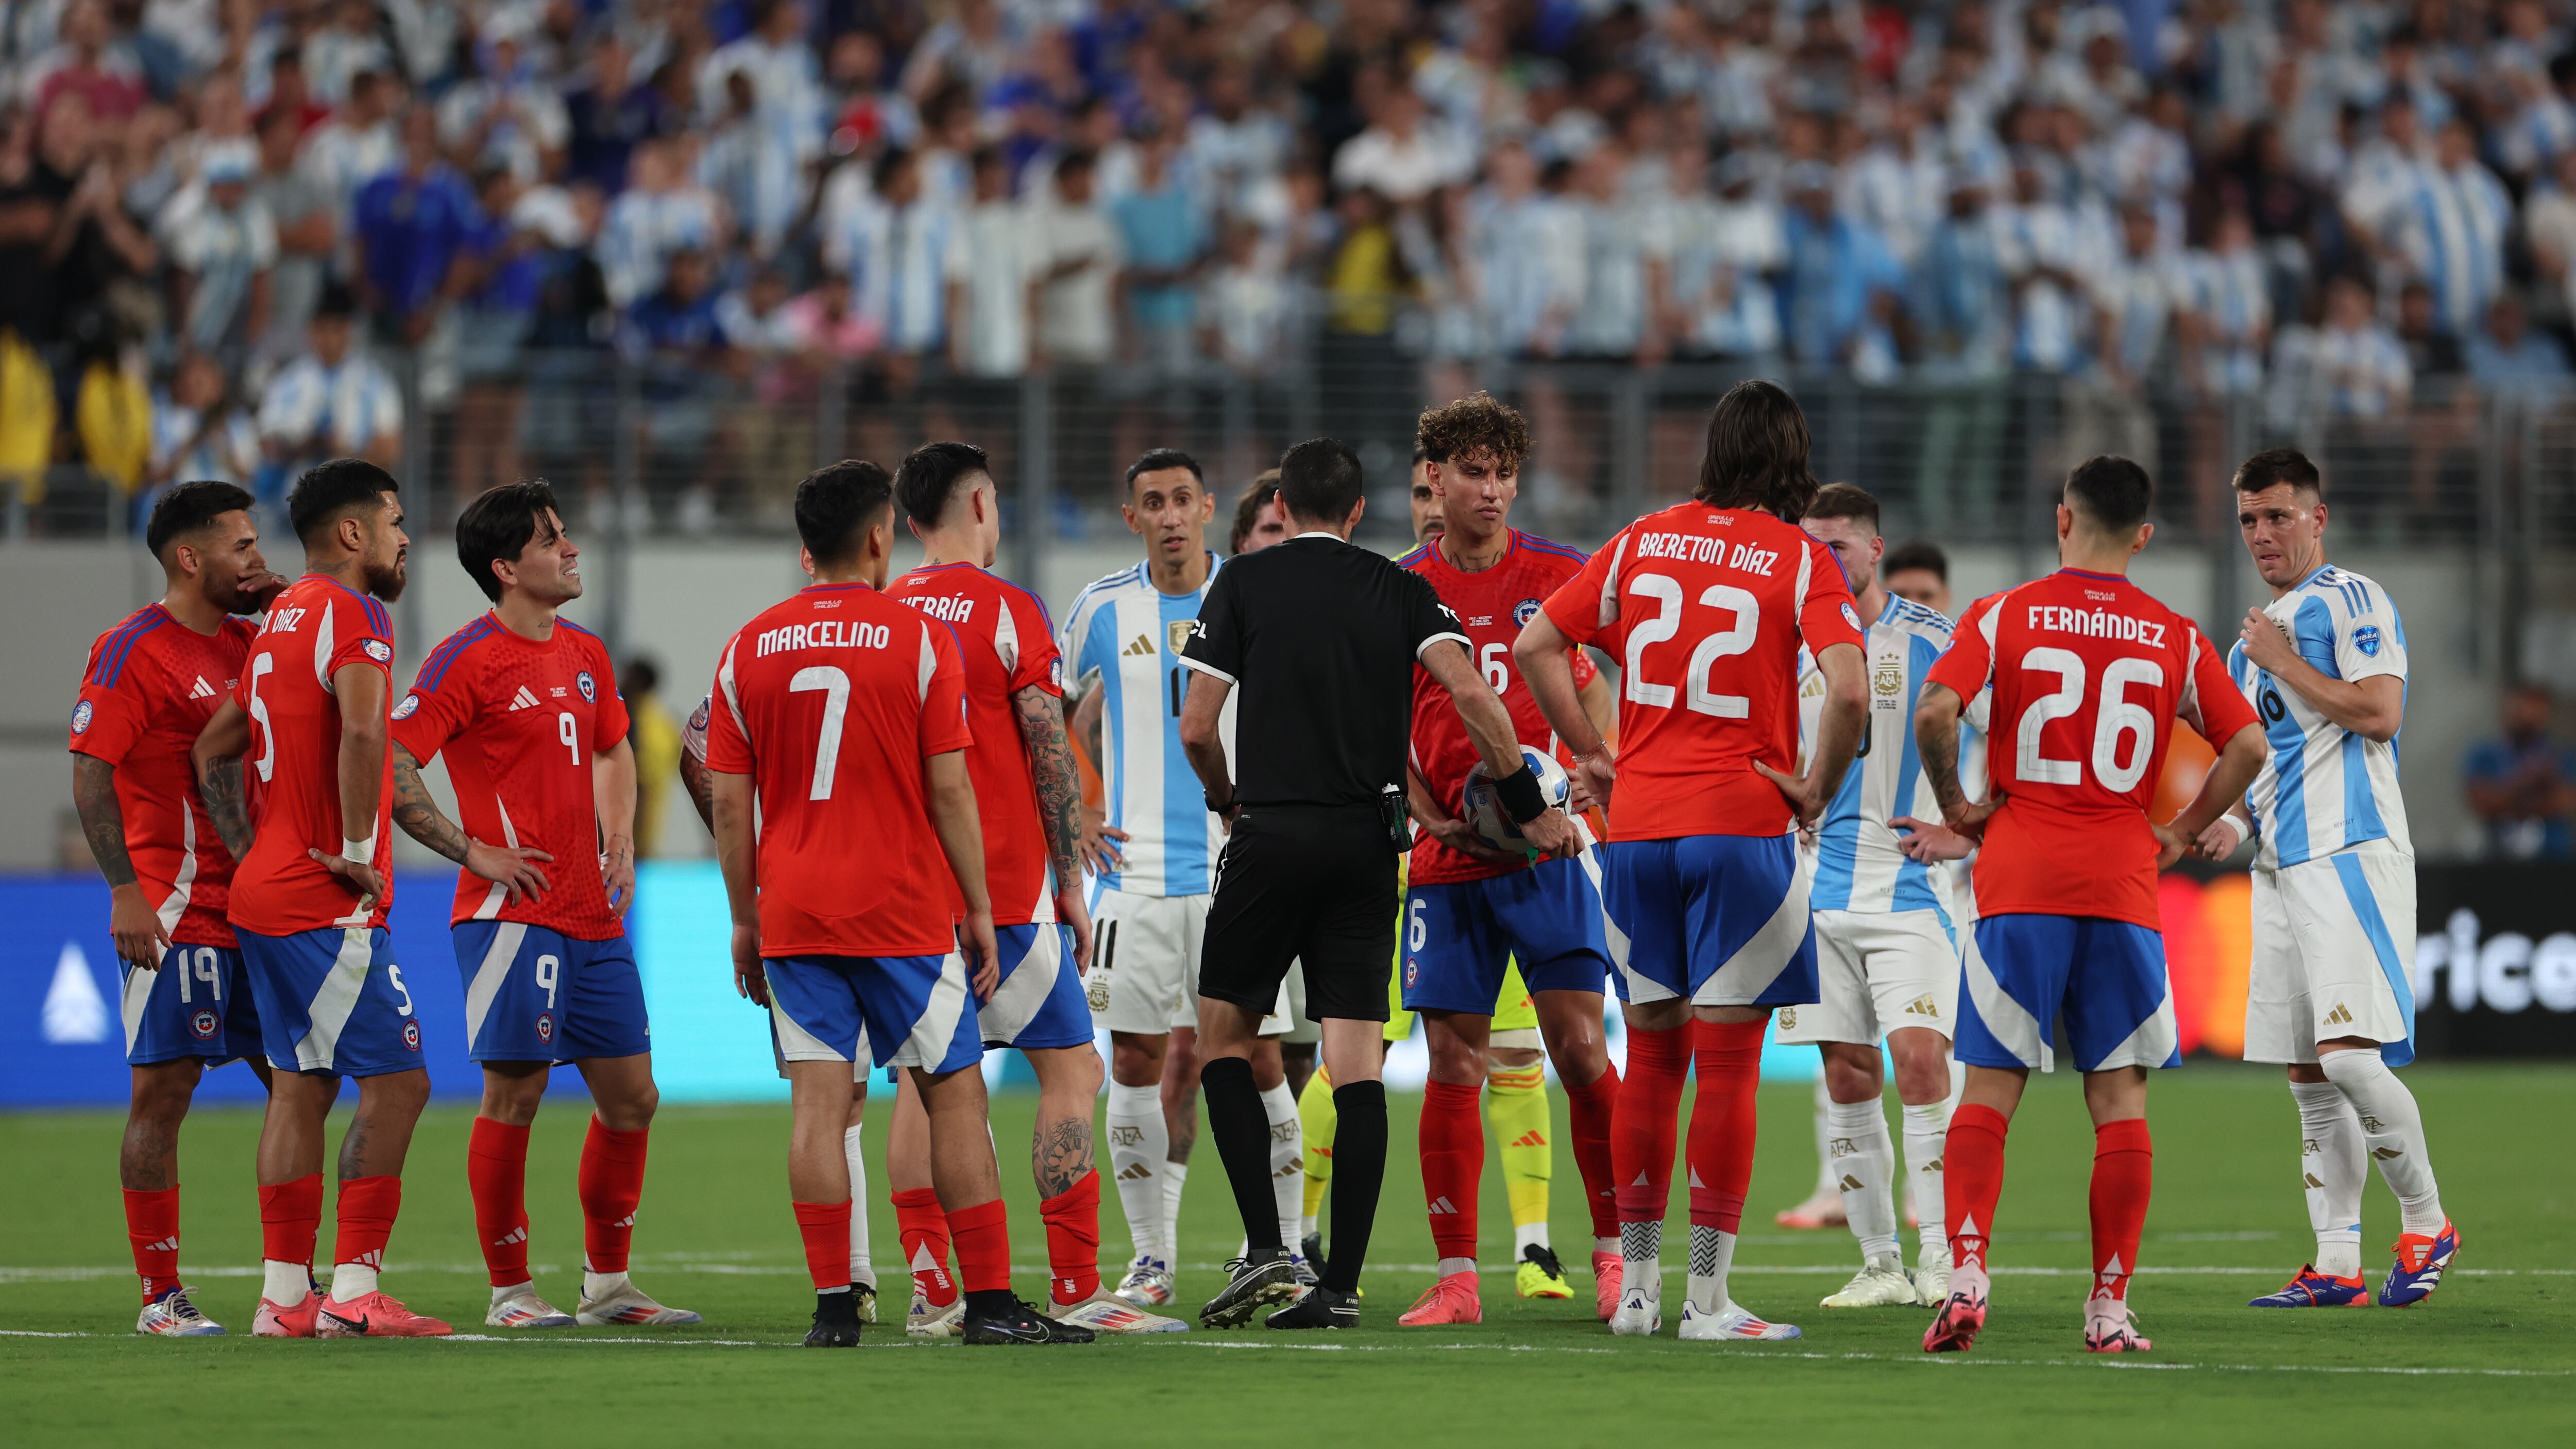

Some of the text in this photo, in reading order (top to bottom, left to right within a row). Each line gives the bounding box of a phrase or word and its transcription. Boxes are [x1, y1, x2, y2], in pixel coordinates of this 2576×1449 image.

[1637, 532, 1778, 577] BRERETON DÍAZ
[271, 602, 307, 634] DÍAZ
[897, 592, 974, 623] RRÍA
[1189, 618, 1207, 639] CL
[1437, 603, 1461, 623] TC
[2028, 606, 2165, 649] FERNÁNDEZ
[756, 621, 890, 658] MARCELINO
[1625, 572, 1760, 719] 22
[2355, 632, 2378, 643] VIBRA
[1481, 643, 1509, 696] 6
[249, 651, 275, 783] 5
[558, 712, 580, 766] 9
[789, 665, 851, 801] 7
[2015, 646, 2164, 793] 26
[1092, 918, 1118, 970] 11
[1409, 898, 1427, 953] 6
[178, 947, 221, 1004] 19
[388, 964, 413, 1016] 5
[536, 954, 560, 1009] 9
[1111, 1126, 1145, 1146] AFA
[1830, 1137, 1859, 1158] AFA
[2301, 1139, 2322, 1156] FA
[321, 1315, 338, 1326] AGUS
